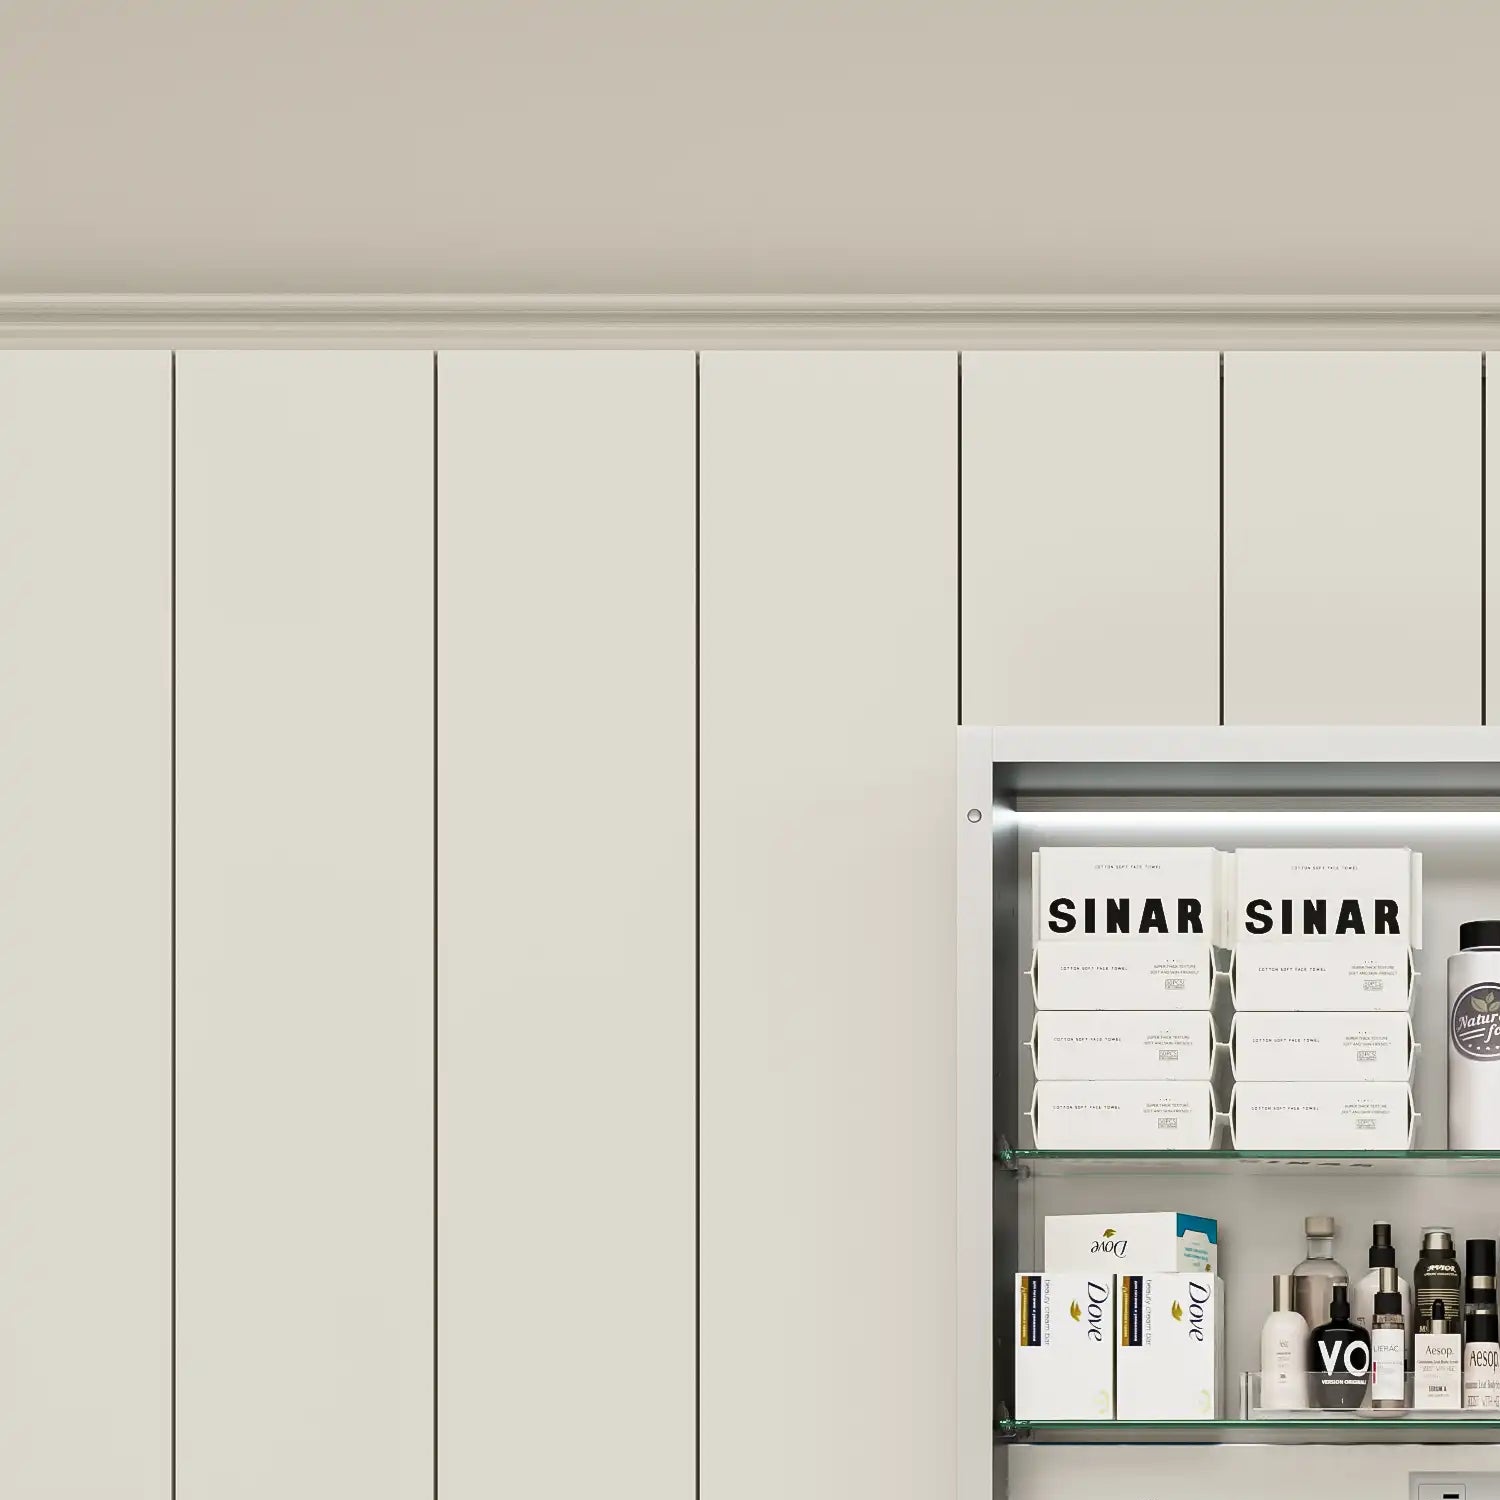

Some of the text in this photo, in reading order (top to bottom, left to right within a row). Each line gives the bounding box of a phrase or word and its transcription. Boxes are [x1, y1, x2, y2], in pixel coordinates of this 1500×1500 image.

[1048, 898, 1203, 933] SINAR
[1245, 899, 1400, 934] SINAR
[1091, 1240, 1128, 1258] Dove
[1087, 1281, 1109, 1342] Dove
[1188, 1281, 1212, 1342] Dove
[1317, 1340, 1369, 1377] VO
